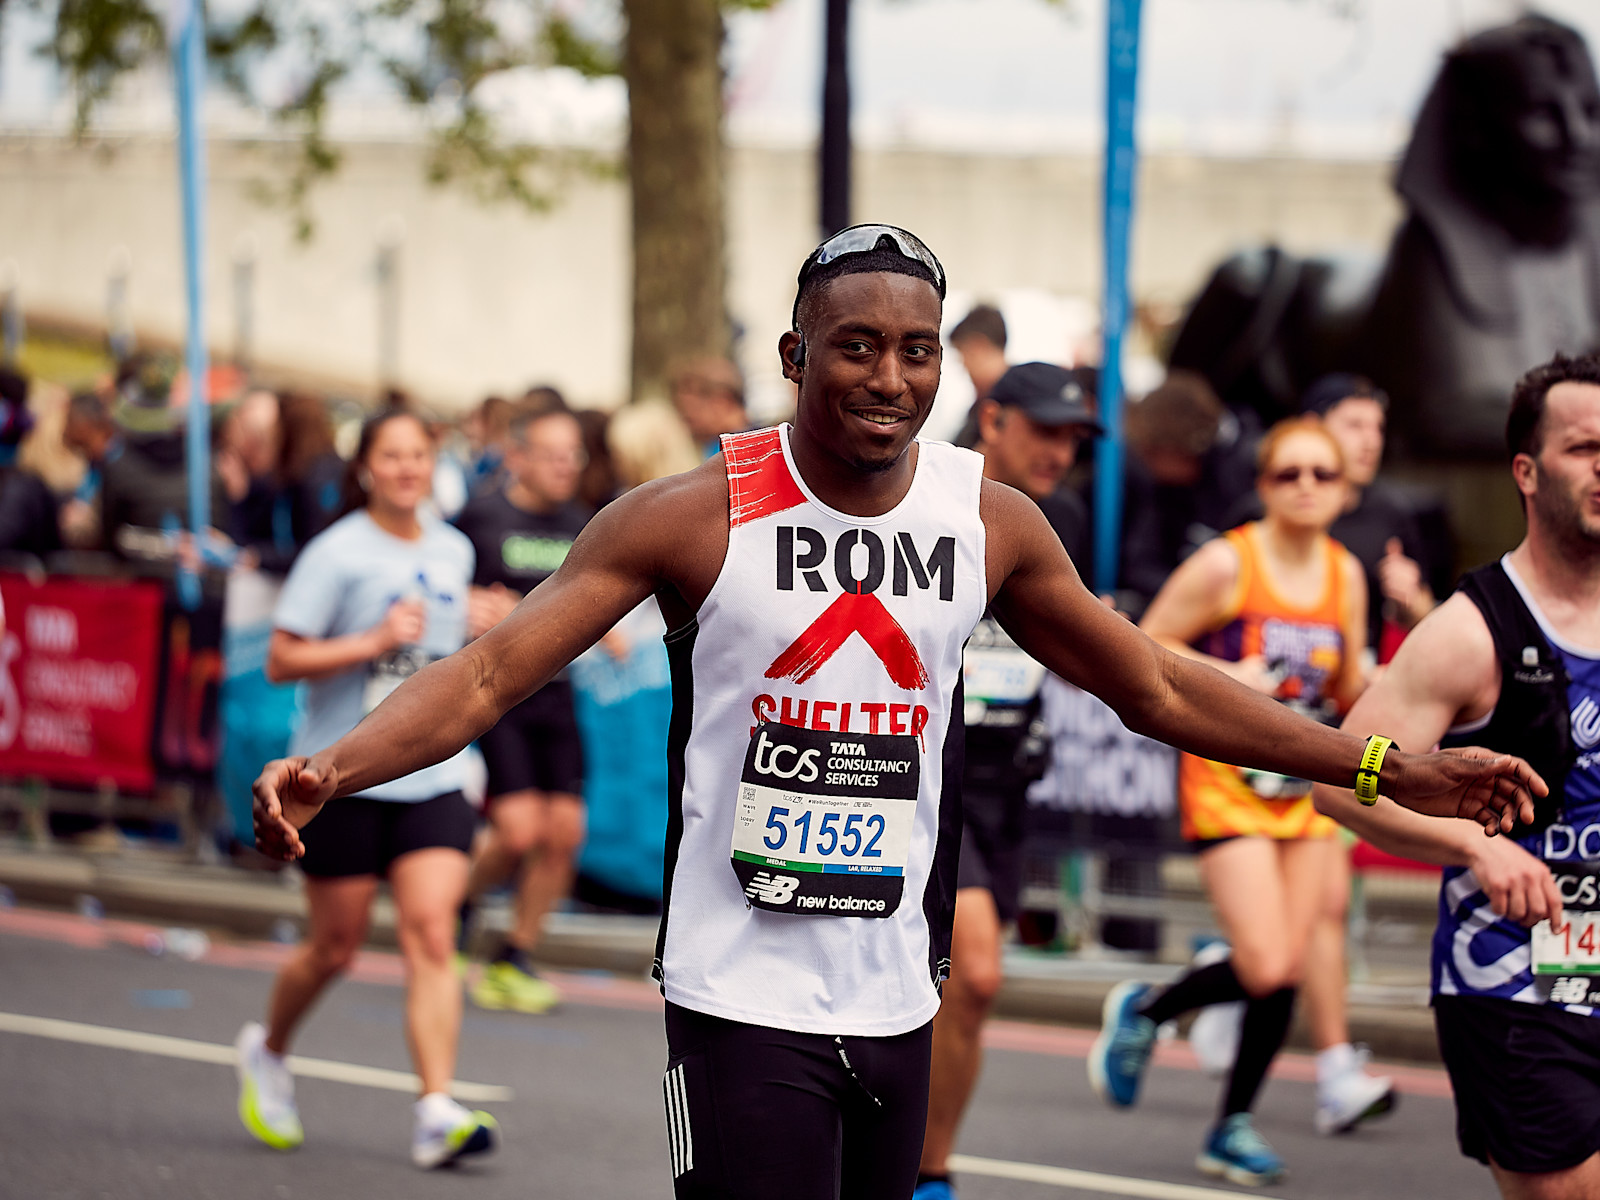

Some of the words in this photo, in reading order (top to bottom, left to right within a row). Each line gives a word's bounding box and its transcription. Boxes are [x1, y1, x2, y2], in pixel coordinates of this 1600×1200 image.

[777, 526, 956, 602] ROM
[753, 731, 821, 782] tcs
[830, 742, 866, 756] TATA
[827, 757, 911, 774] CONSULTANCY
[825, 772, 879, 787] SERVICES
[808, 799, 849, 807] #WeRunTogether
[763, 805, 886, 858] 51552
[766, 858, 787, 867] MEDAL
[861, 865, 883, 874] RELAXED
[1552, 873, 1597, 906] cs
[797, 896, 827, 909] new
[829, 895, 886, 911] balance
